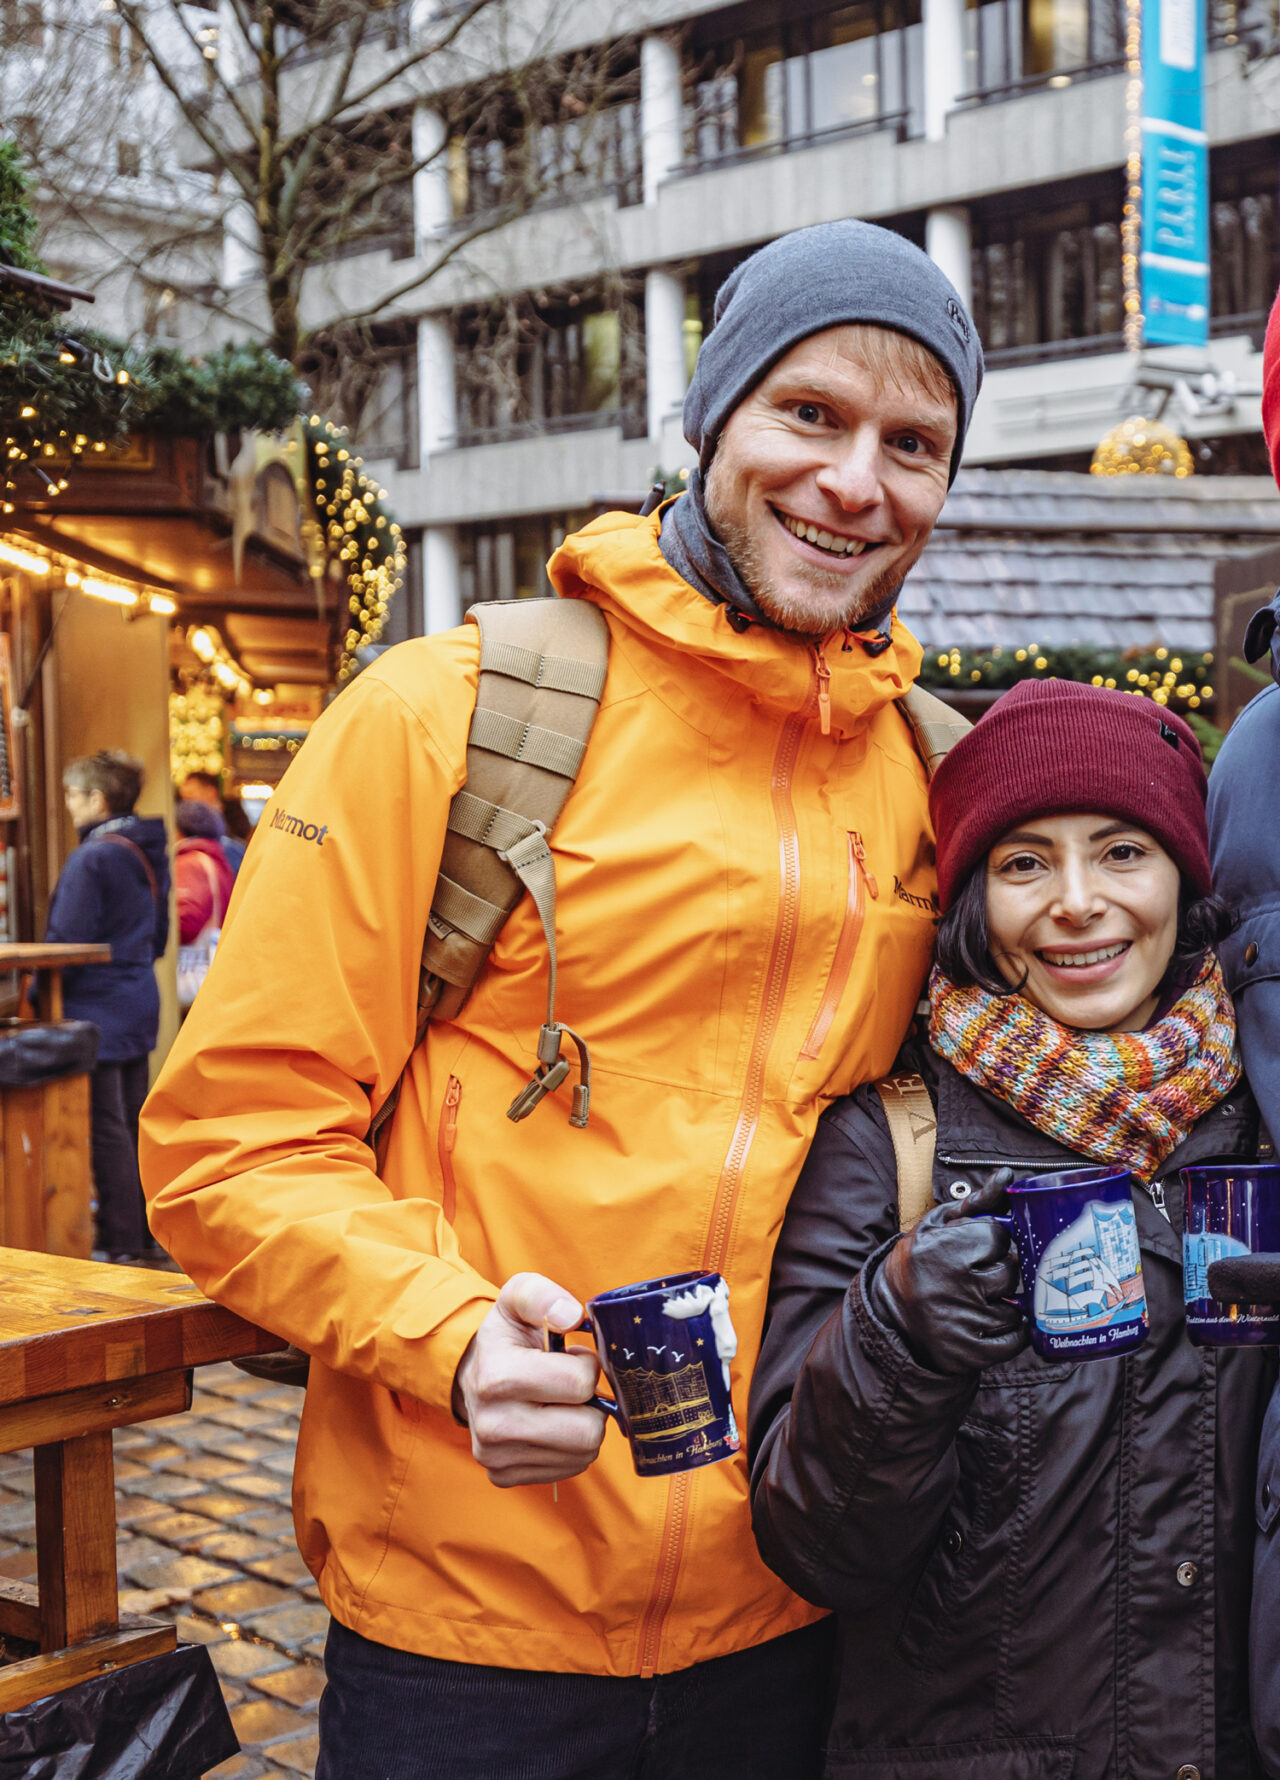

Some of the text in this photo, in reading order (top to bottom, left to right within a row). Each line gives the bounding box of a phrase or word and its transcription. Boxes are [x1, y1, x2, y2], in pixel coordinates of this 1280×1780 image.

[269, 807, 328, 846] Marmot
[893, 874, 939, 917] Marm
[1050, 1325, 1139, 1349] Weihnachten in Hamburg
[675, 1448, 684, 1460] in
